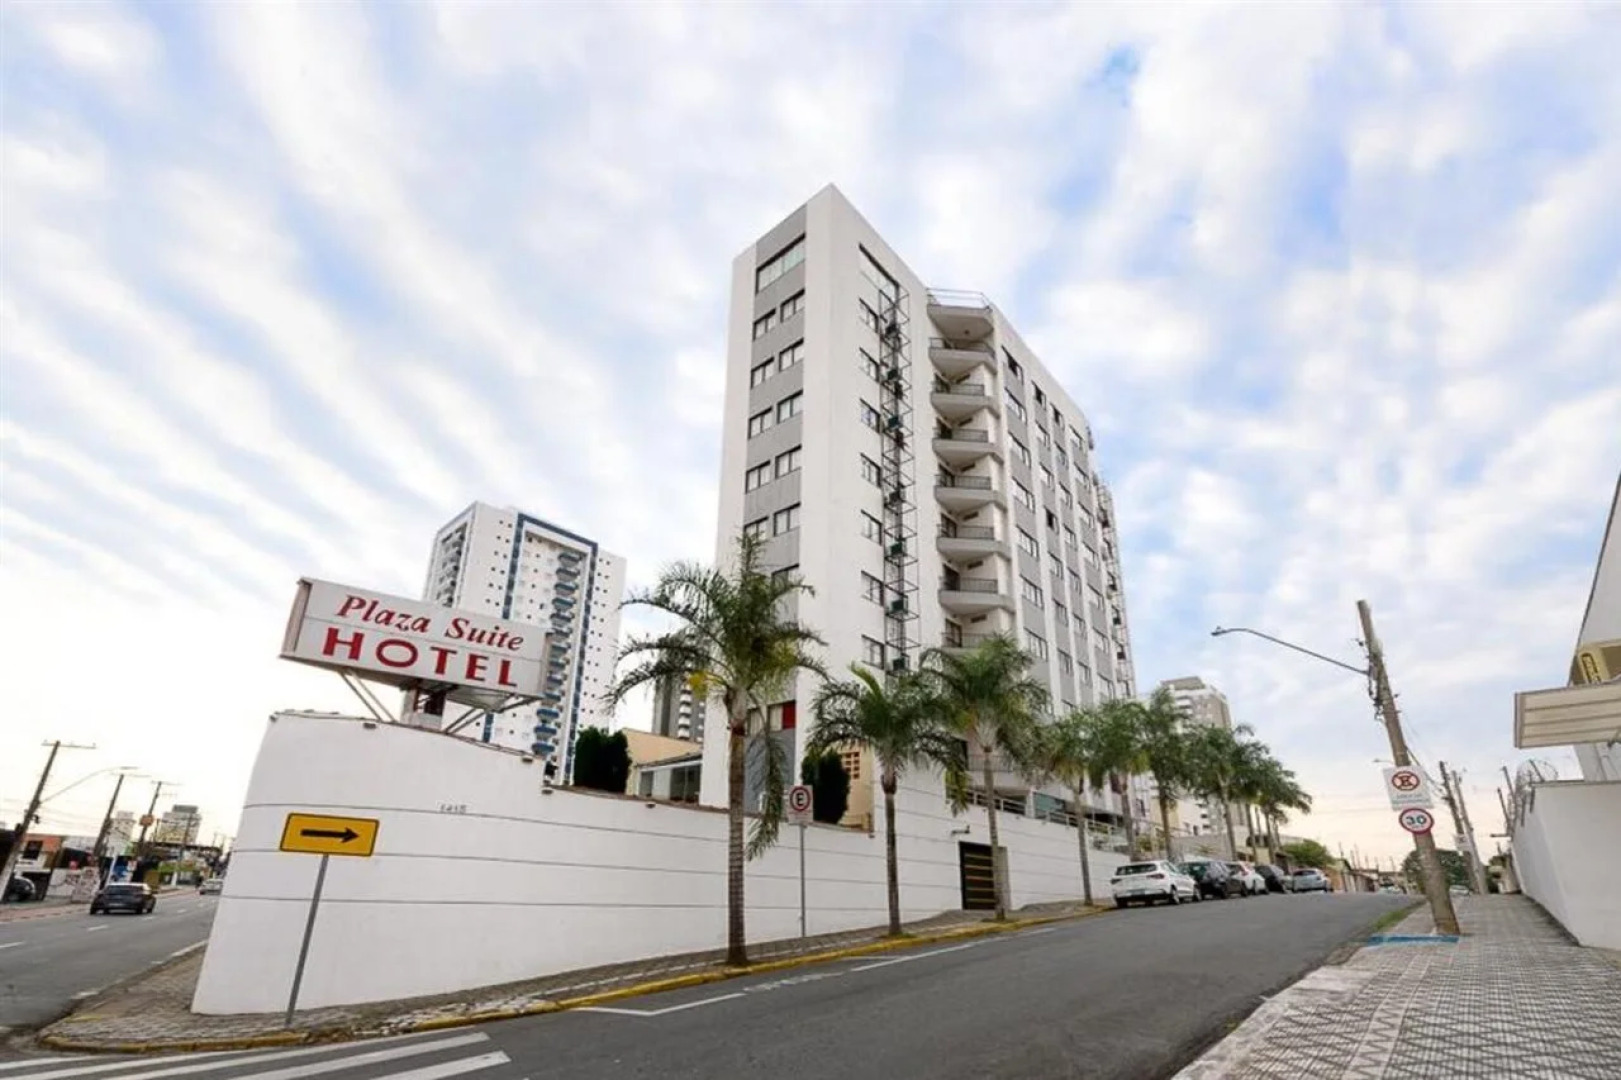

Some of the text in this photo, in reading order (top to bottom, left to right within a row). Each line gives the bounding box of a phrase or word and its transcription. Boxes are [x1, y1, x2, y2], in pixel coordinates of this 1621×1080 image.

[336, 594, 524, 651] Plaza Suite
[322, 627, 518, 687] HOTEL
[796, 792, 804, 806] E
[1405, 815, 1427, 825] 30
